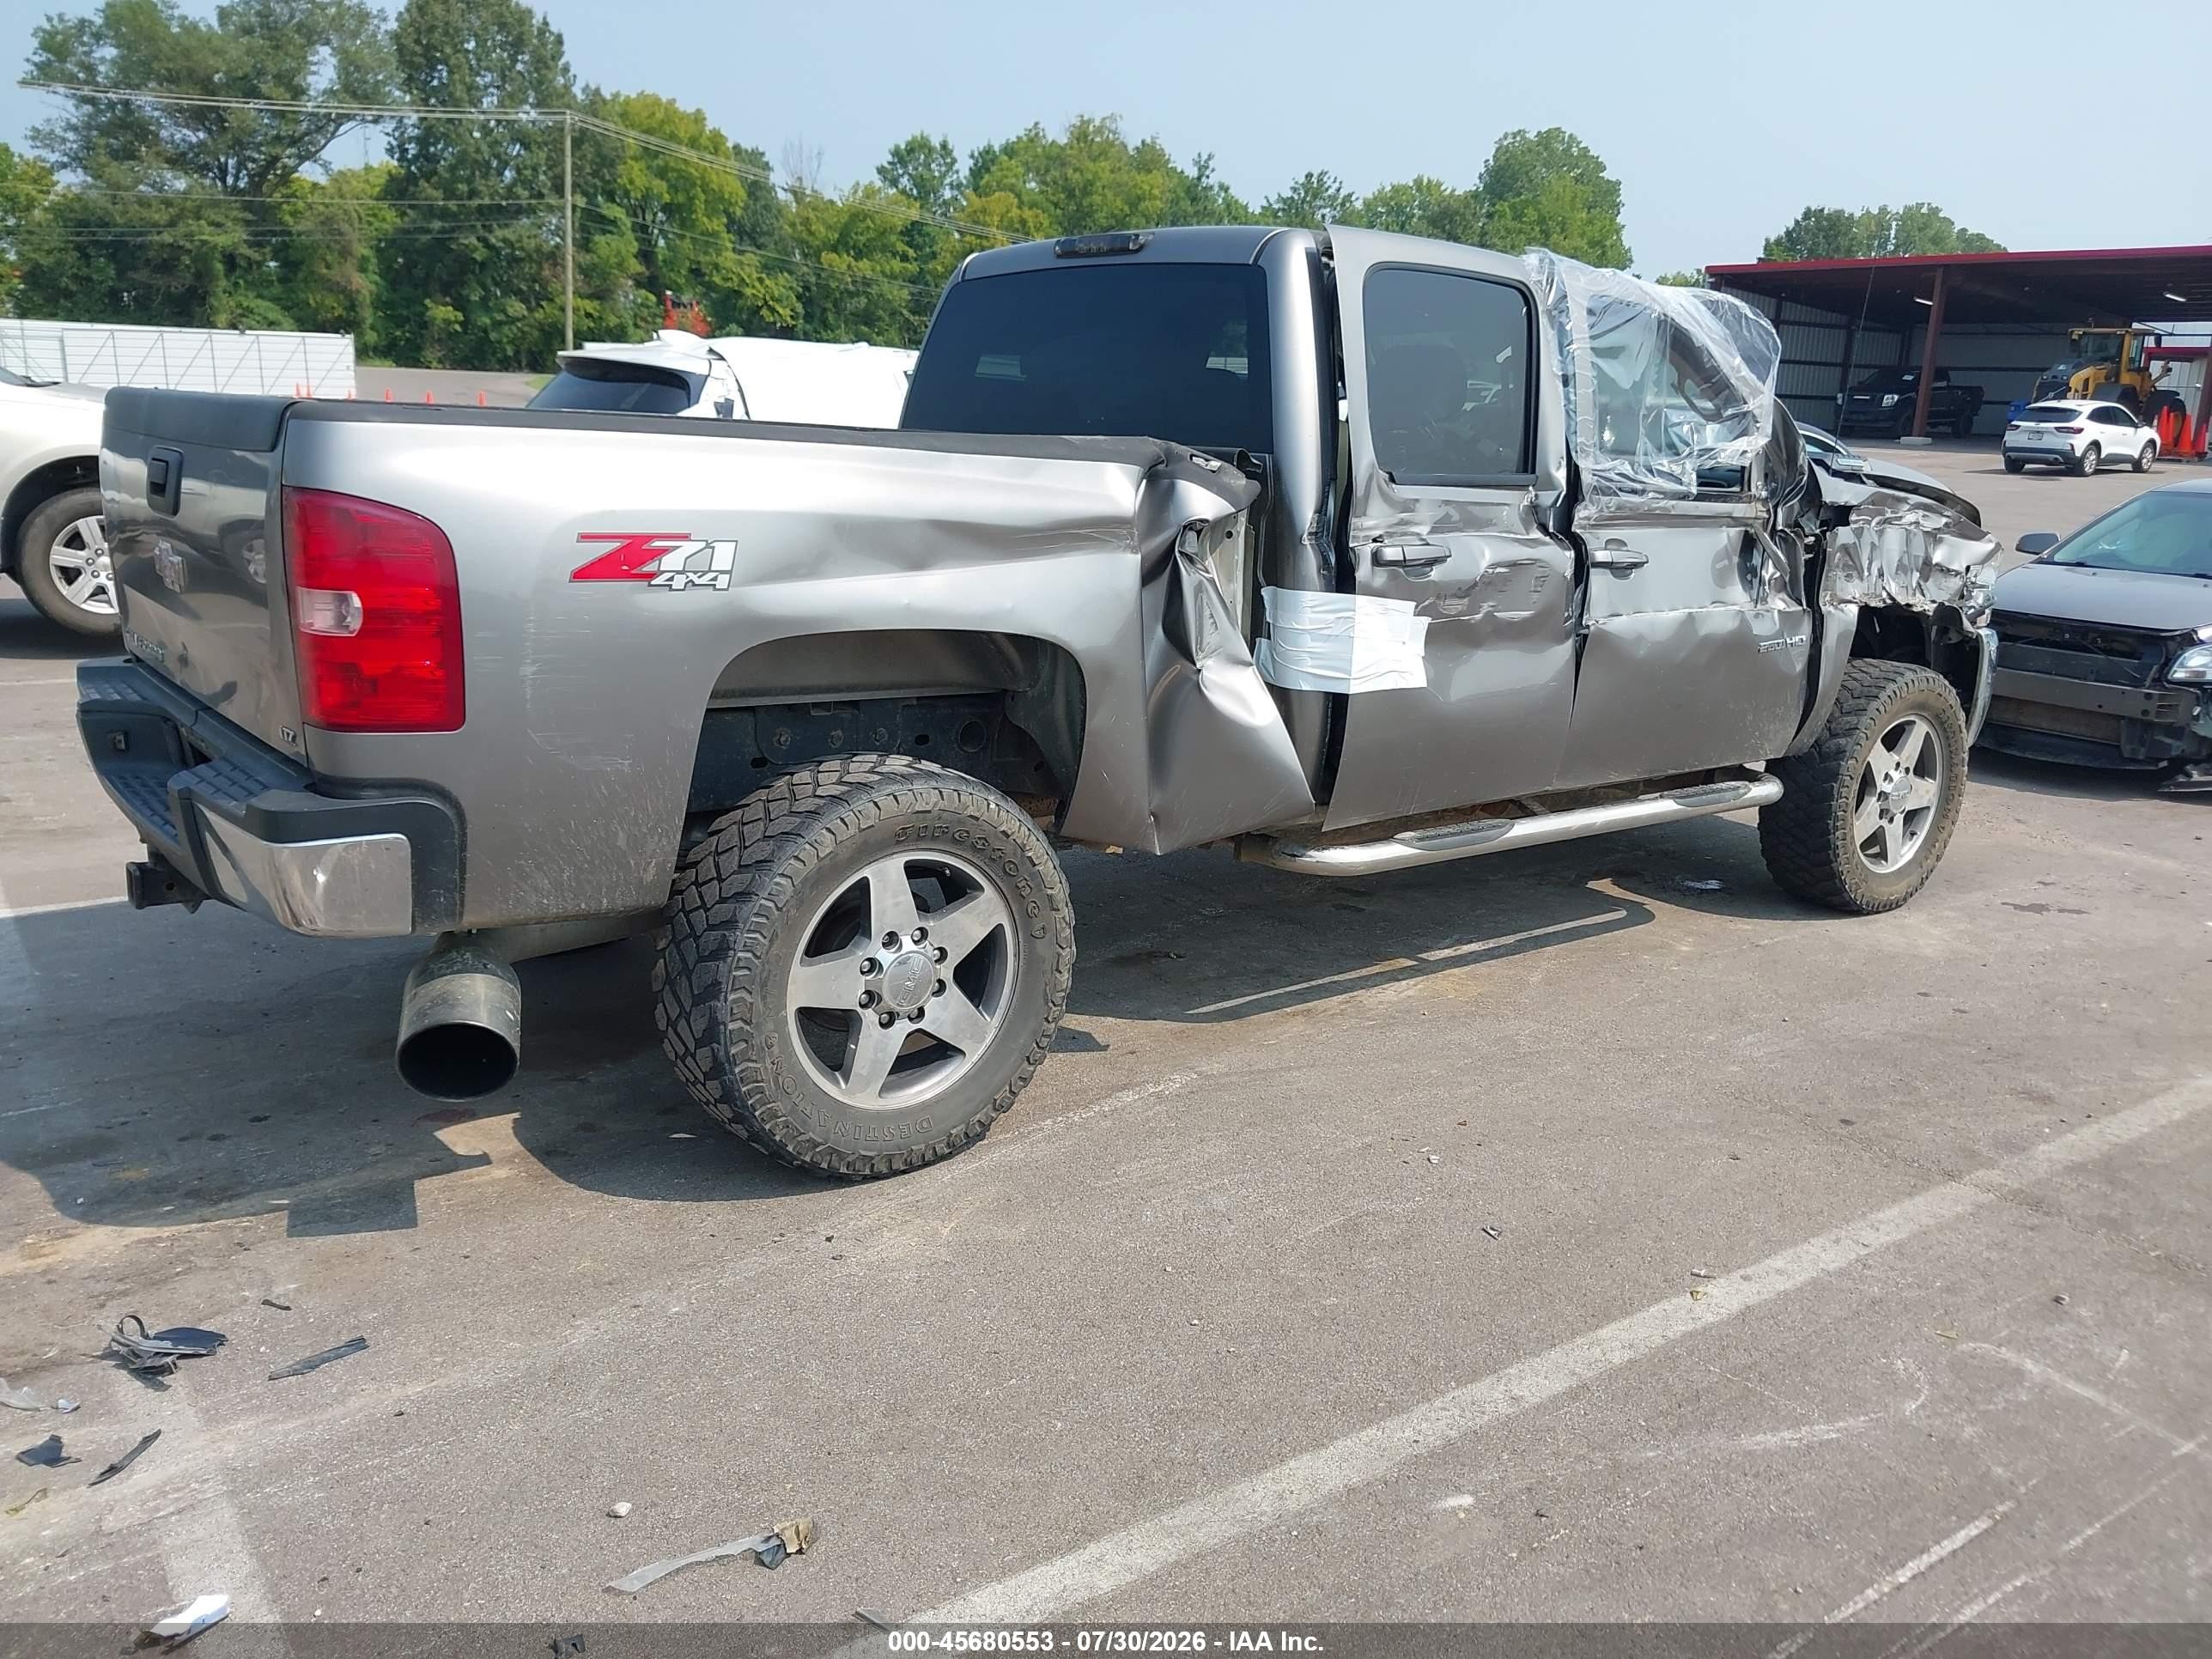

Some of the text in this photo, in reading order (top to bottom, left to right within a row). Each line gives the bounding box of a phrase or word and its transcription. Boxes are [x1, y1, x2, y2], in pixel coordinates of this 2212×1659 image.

[568, 532, 738, 583] Z71
[894, 823, 1041, 920] Firestone
[896, 954, 923, 1006] GMC
[770, 1055, 934, 1142] DESTINATION
